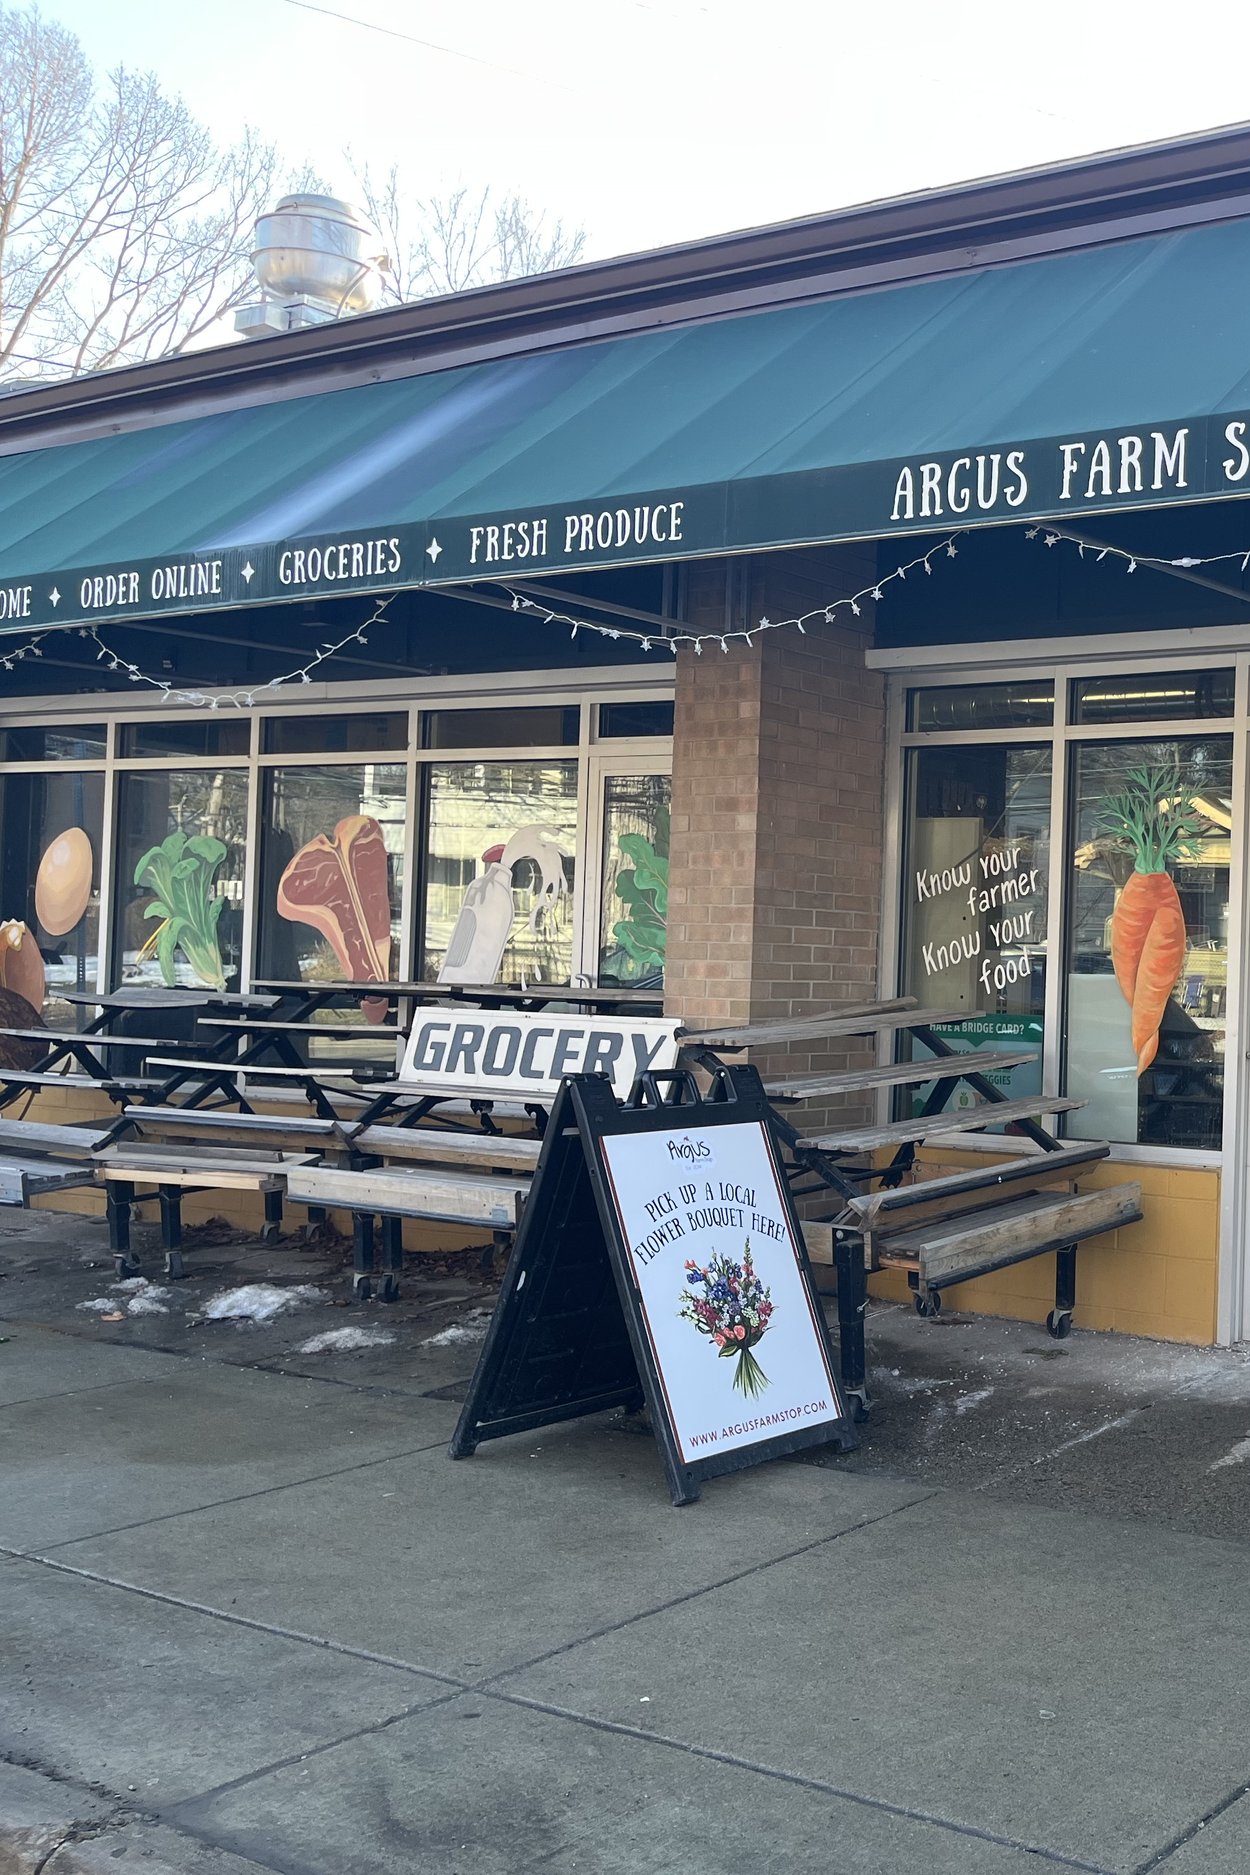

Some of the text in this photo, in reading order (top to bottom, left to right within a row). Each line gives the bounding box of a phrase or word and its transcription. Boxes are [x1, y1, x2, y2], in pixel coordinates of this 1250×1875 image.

[890, 451, 1030, 521] ARGUS
[1059, 428, 1190, 499] FARM
[80, 573, 139, 609] ORDER
[151, 560, 222, 599] ONLINE
[279, 537, 402, 586] GROCERIES
[469, 518, 547, 564] FRESH
[563, 502, 684, 553] PRODUCE
[916, 863, 971, 902] Know
[967, 869, 1039, 916] farmer
[922, 931, 980, 976] Know
[979, 945, 1031, 995] food
[962, 1022, 993, 1034] BRIDGE
[996, 1023, 1024, 1035] CARD?
[413, 1022, 667, 1084] GROCERY
[666, 1140, 710, 1163] Argus
[644, 1182, 757, 1223] PICK UP A LOCAL
[634, 1207, 786, 1266] FLOWER BOUQUET HERE!
[688, 1400, 828, 1448] WWW.ARGUSFARMSTOP.COM
